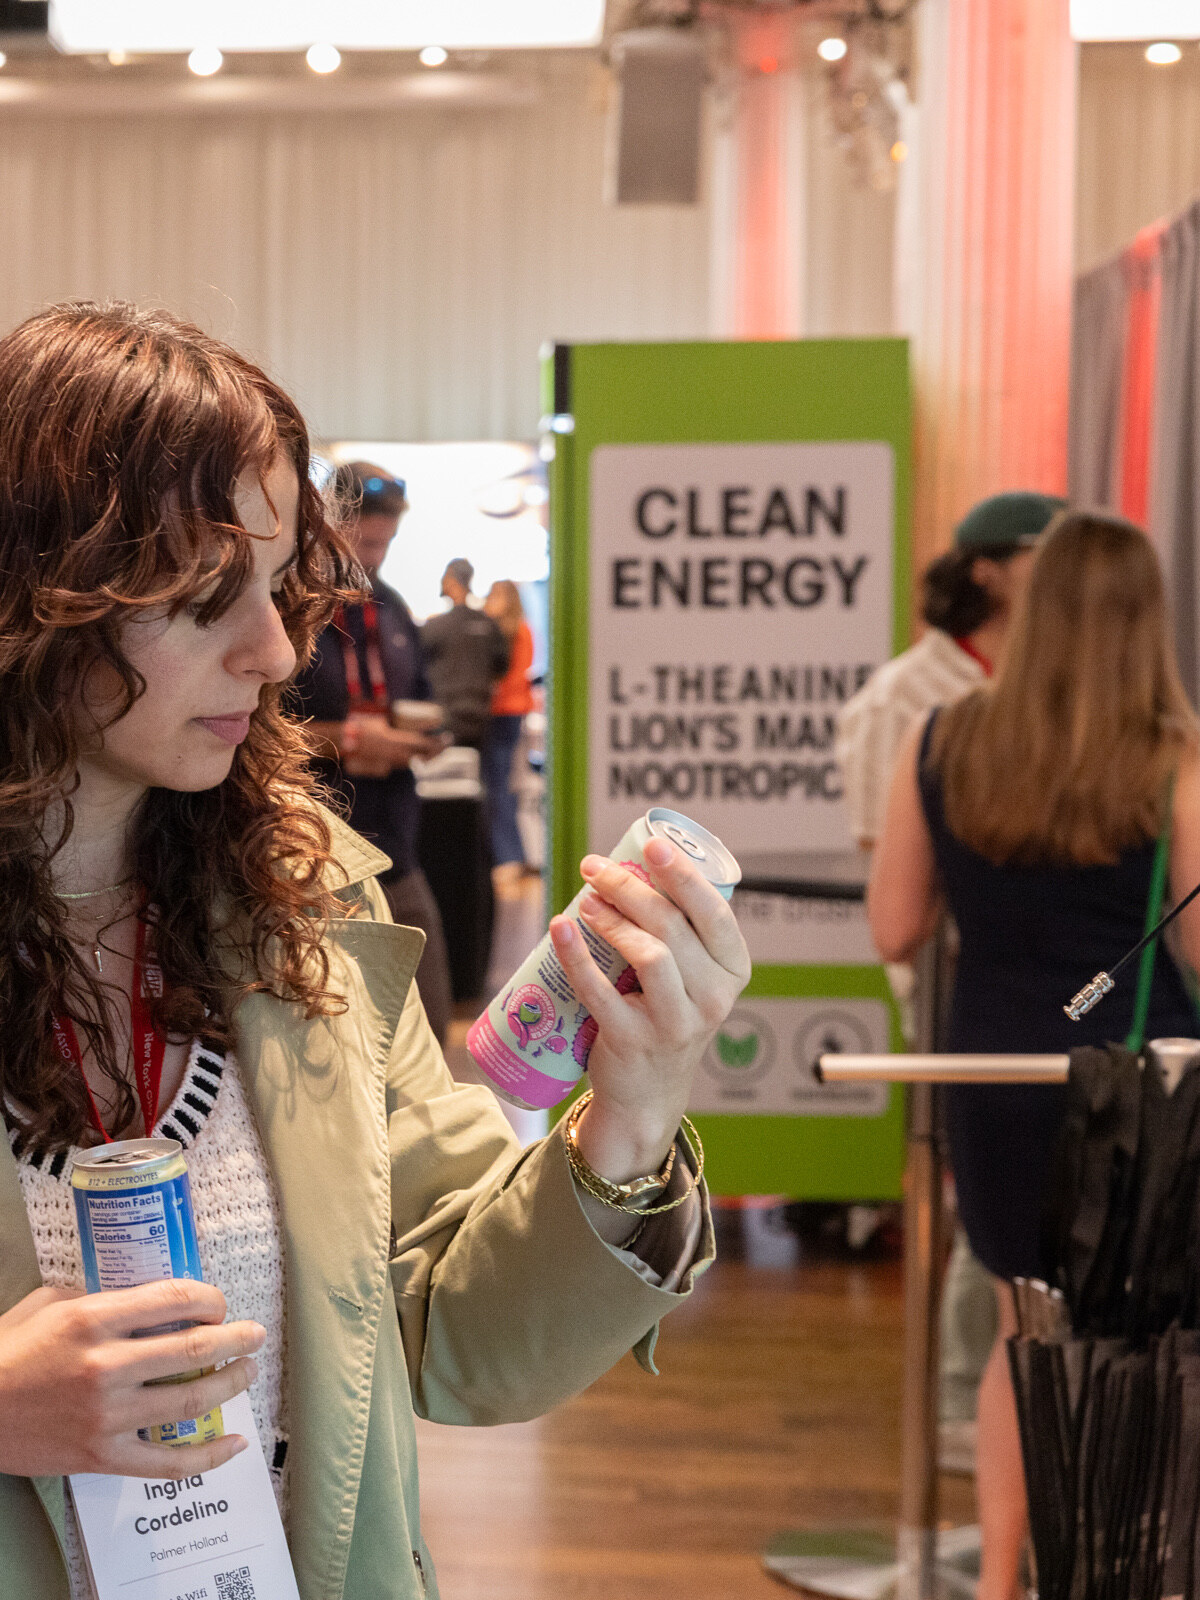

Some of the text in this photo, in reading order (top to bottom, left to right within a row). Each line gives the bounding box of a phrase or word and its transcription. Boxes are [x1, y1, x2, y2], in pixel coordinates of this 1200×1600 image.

[635, 485, 846, 540] CLEAN
[610, 555, 869, 610] ENERGY
[609, 713, 740, 752] LION'S
[531, 1018, 554, 1039] WATER
[143, 1032, 154, 1058] New
[143, 1060, 153, 1089] York
[88, 1178, 100, 1186] B12
[108, 1172, 158, 1186] ELECTROLYTES
[89, 1199, 131, 1209] Nutrition
[133, 1195, 160, 1207] Facts
[94, 1224, 165, 1240] Calories 60
[134, 1499, 229, 1535] Cordelino
[150, 1531, 229, 1562] Palmer Holland
